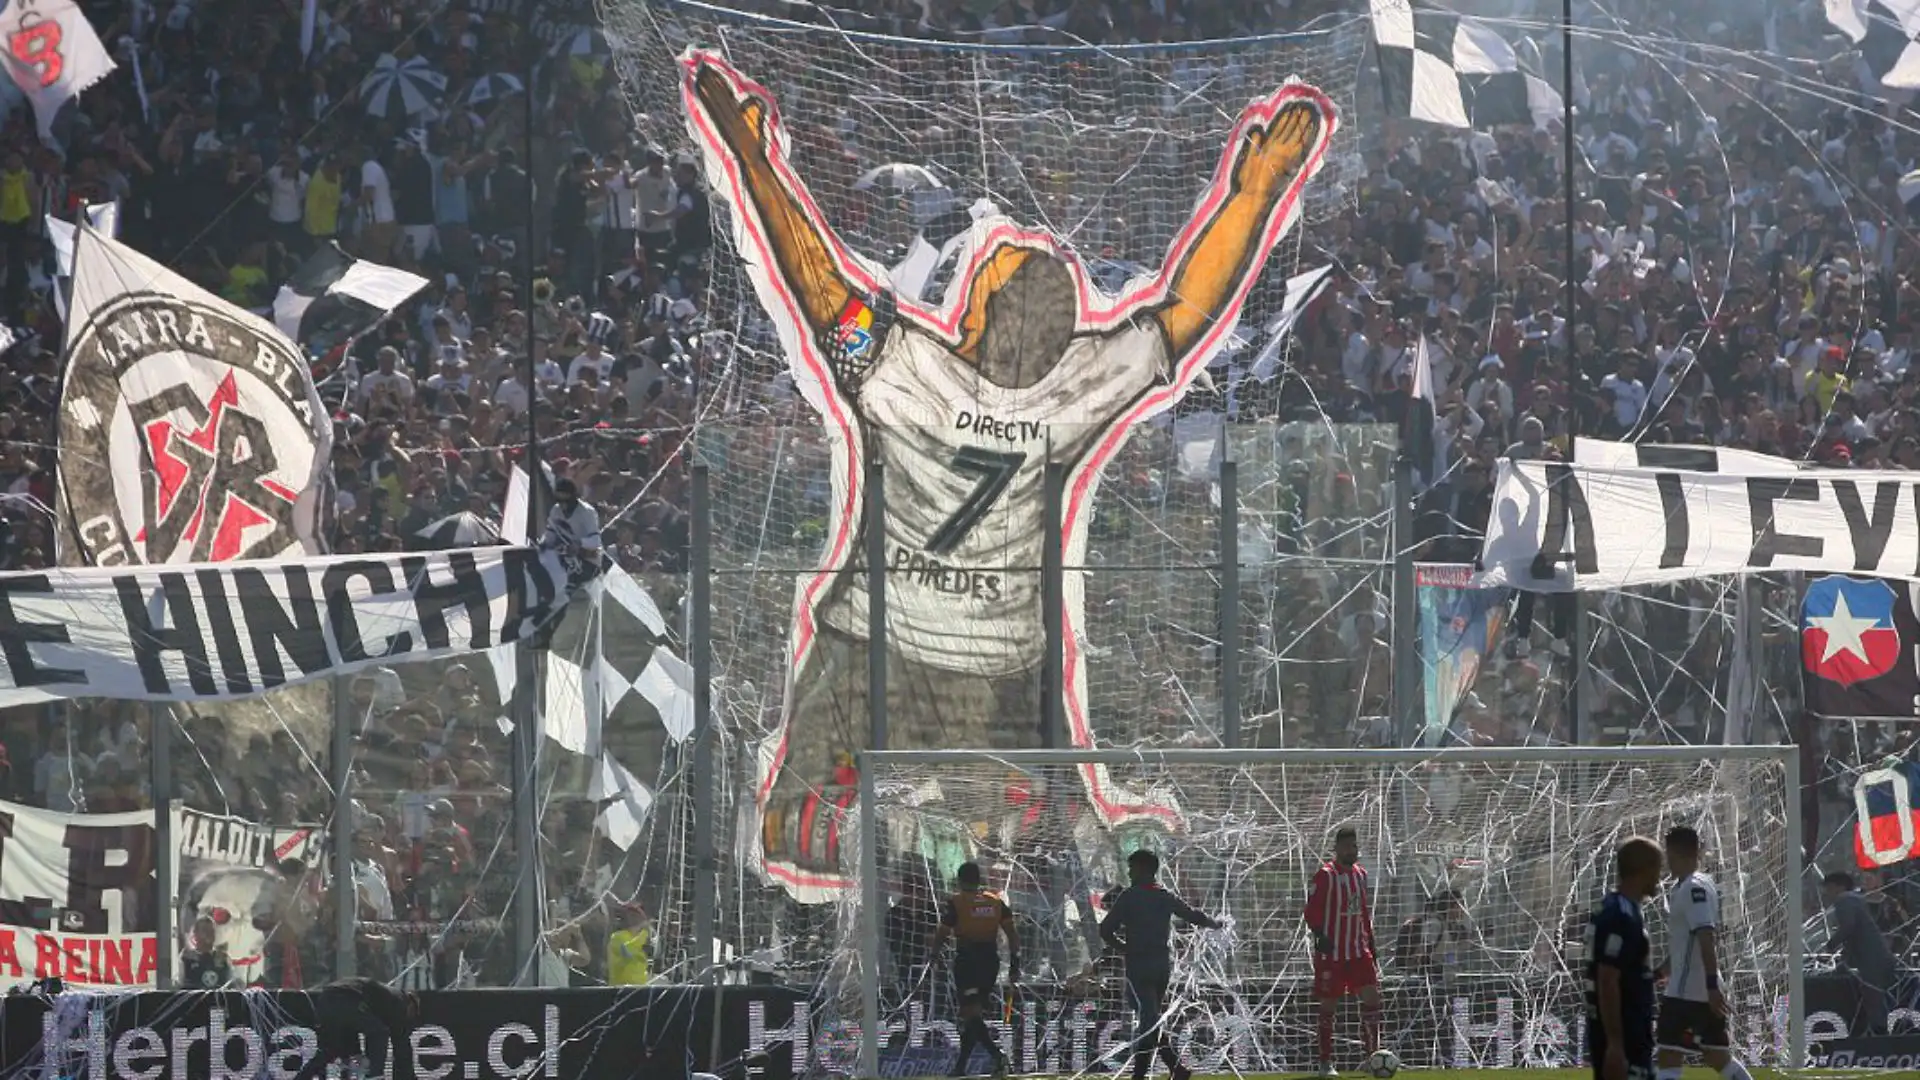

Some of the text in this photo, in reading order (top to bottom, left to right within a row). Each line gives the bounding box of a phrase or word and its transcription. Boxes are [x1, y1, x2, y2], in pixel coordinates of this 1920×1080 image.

[923, 445, 1027, 555] 7
[892, 547, 1001, 600] PAREDES
[35, 933, 157, 985] REINA
[43, 1004, 560, 1080] Herbae.cl
